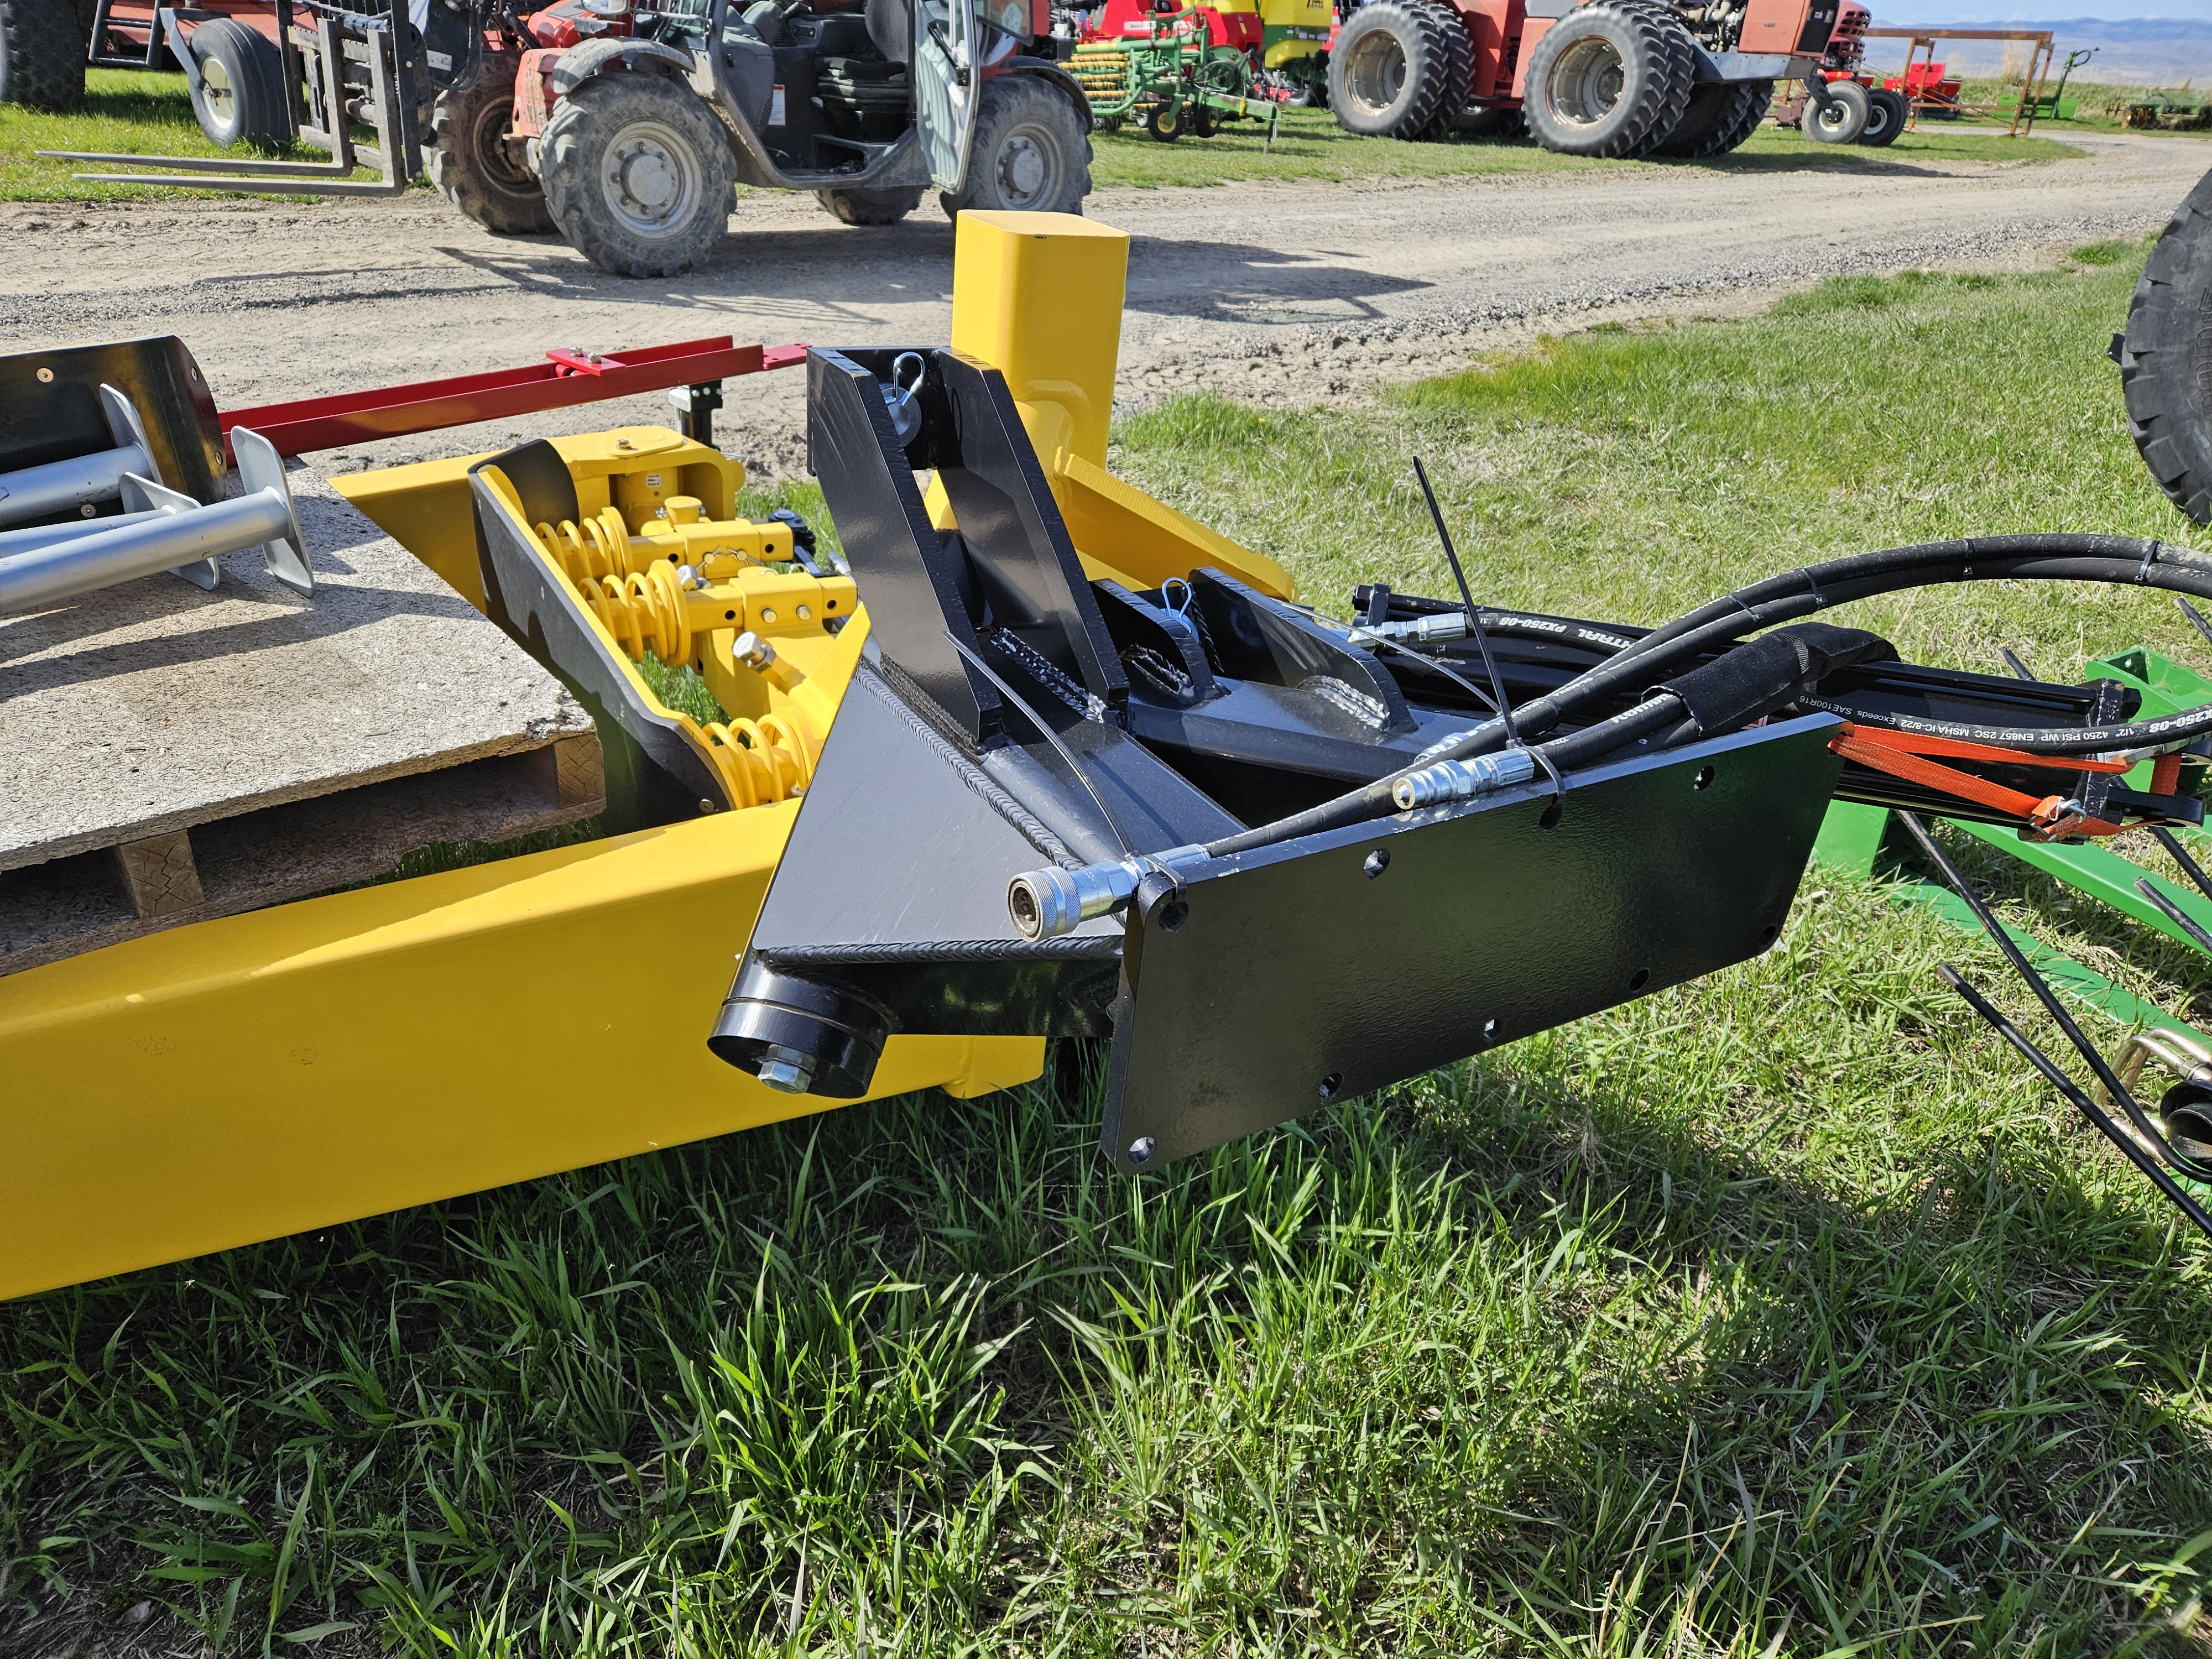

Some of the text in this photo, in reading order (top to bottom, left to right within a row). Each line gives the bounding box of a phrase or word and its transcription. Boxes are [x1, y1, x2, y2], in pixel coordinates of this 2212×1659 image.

[1499, 617, 1567, 633] PX250-08
[1799, 695, 1853, 715] SAE100R16
[1857, 710, 1896, 725] Exceeds
[2149, 709, 2212, 733] X250-08
[1901, 719, 1936, 732] IC-8/22
[1938, 726, 1969, 737] MSHA
[1974, 730, 1996, 739] 2SC
[1999, 732, 2034, 741] EN857
[2063, 733, 2081, 741] PSI
[2083, 731, 2109, 739] 4250
[2115, 728, 2135, 737] 1/2"
